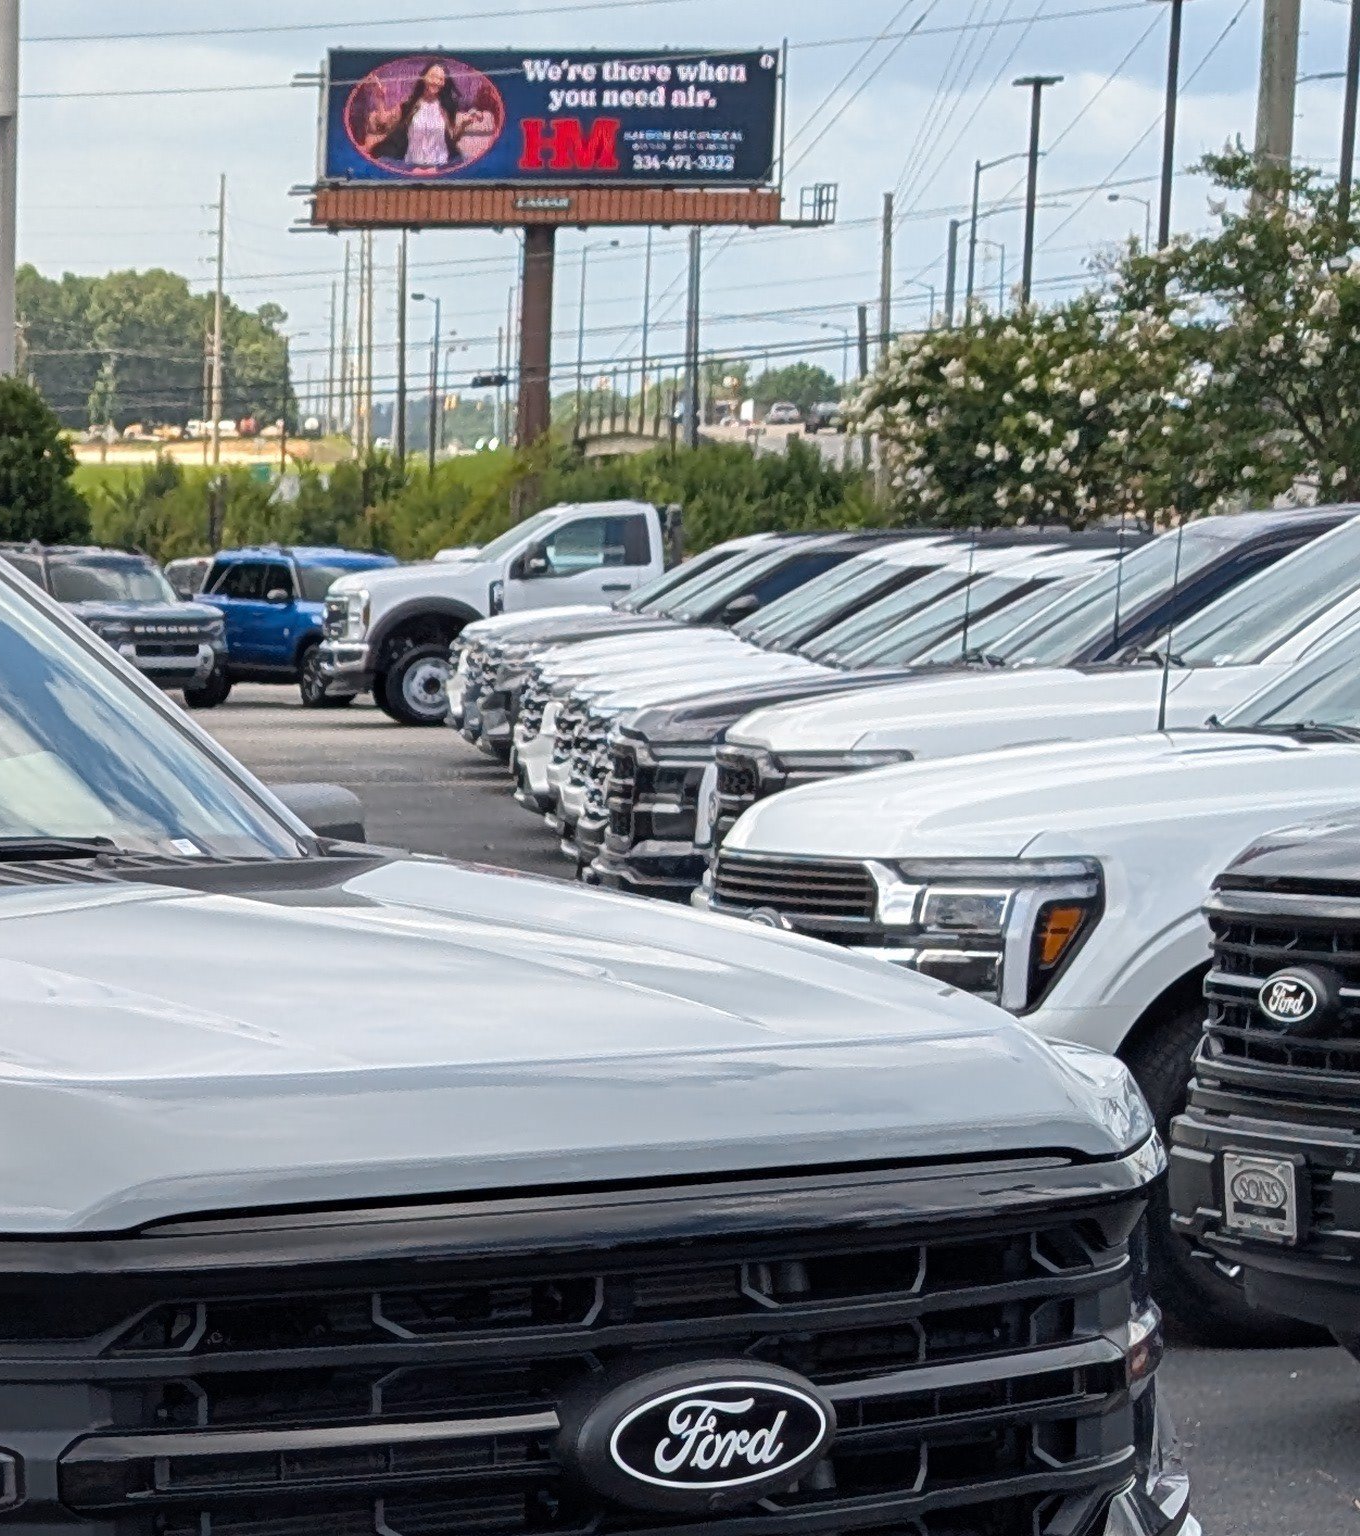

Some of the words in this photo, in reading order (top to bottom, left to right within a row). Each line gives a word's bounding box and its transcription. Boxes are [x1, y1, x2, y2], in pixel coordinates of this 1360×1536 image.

[523, 58, 597, 83] We're
[602, 59, 672, 83] there
[677, 59, 747, 83] when
[548, 88, 597, 112] you
[602, 85, 667, 108] need
[671, 85, 718, 108] air.
[518, 116, 621, 171] HM
[1268, 981, 1306, 1015] Ford
[1239, 1176, 1280, 1205] SONS
[655, 1397, 788, 1474] Ford
